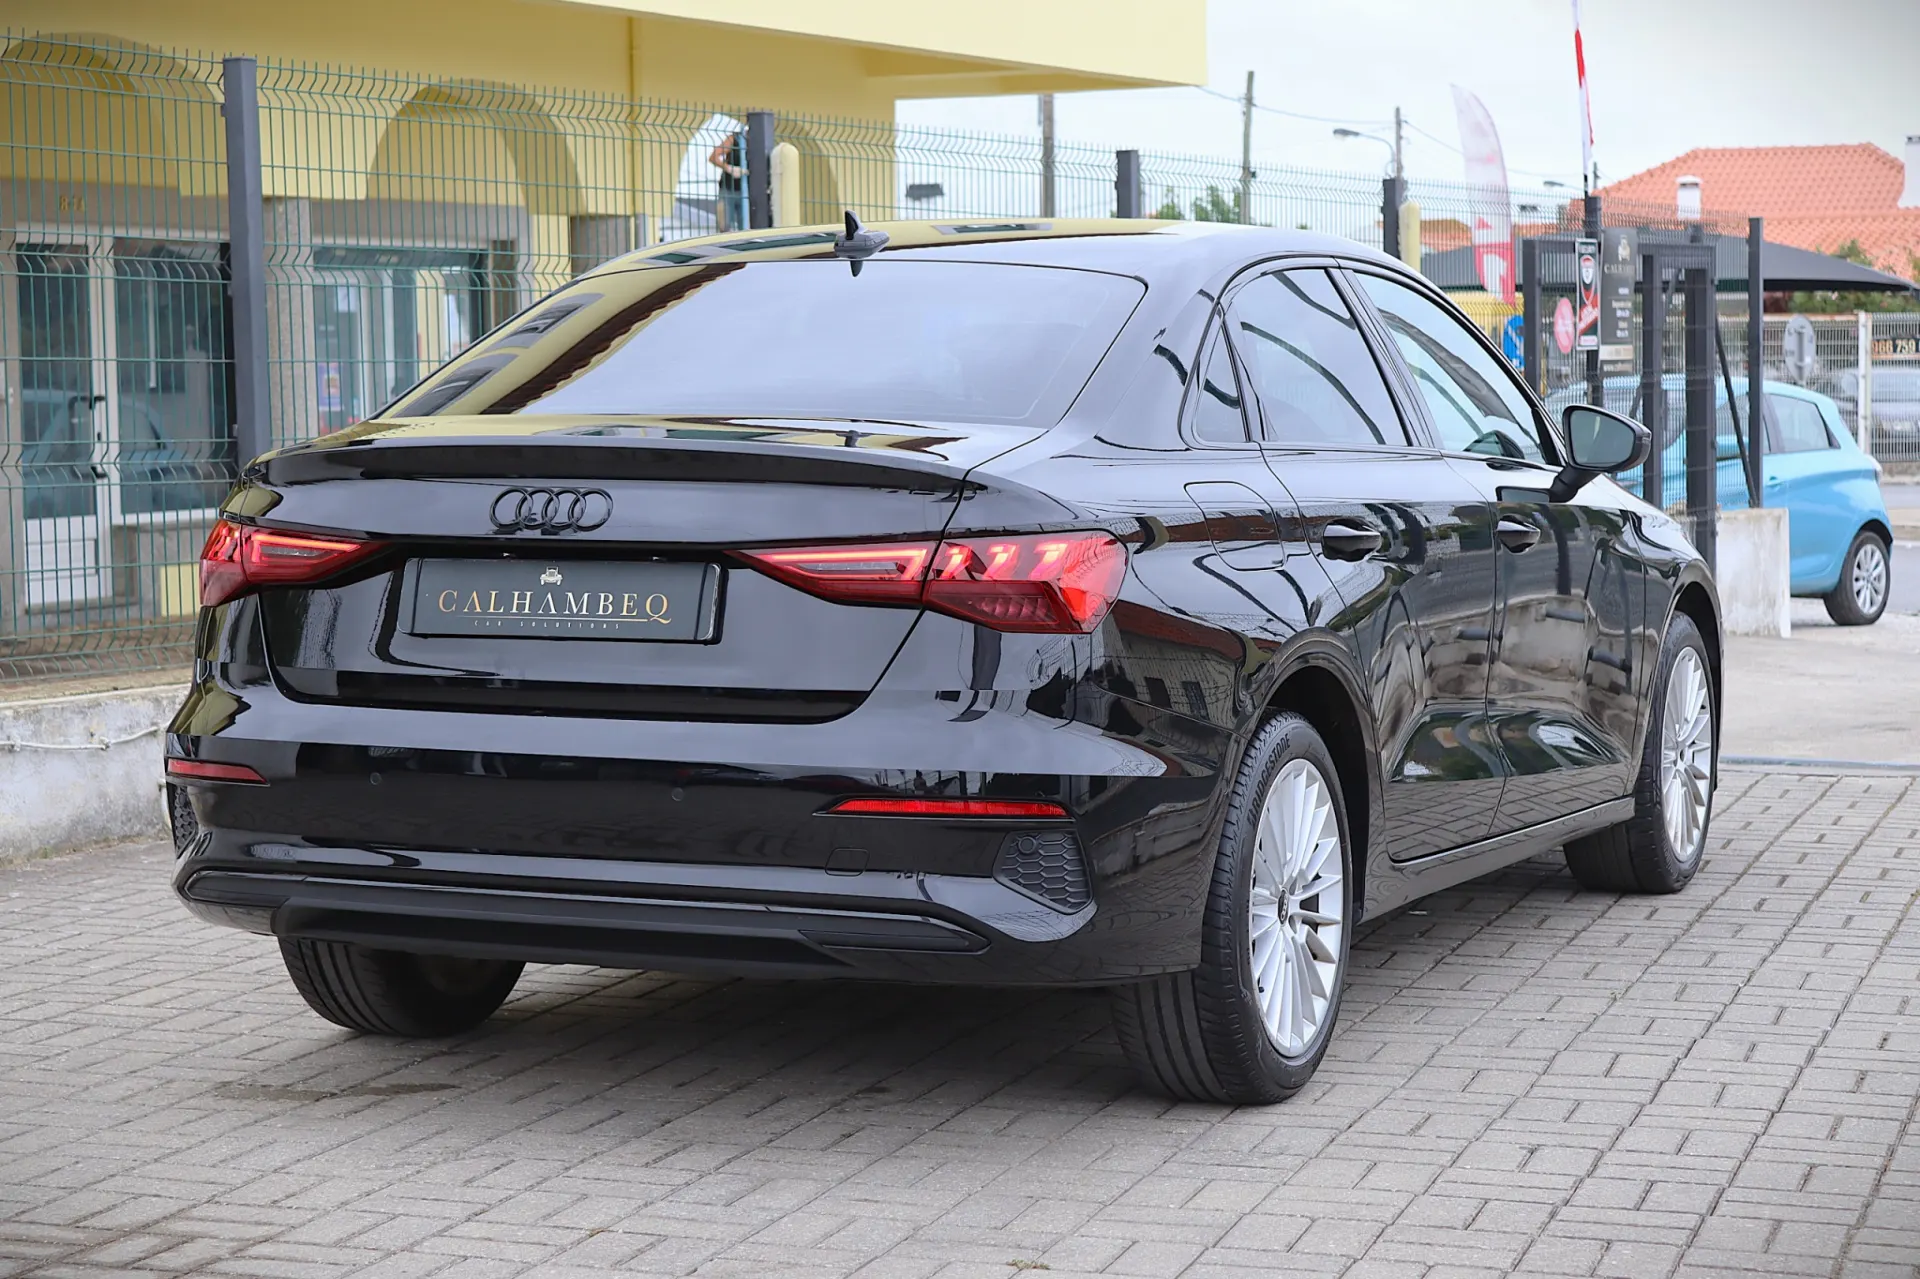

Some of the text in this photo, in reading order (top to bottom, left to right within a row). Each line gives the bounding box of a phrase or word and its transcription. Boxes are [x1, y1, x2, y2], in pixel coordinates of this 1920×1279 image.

[438, 589, 672, 624] CALHAMBEQ
[520, 621, 620, 630] SOLUTIONS
[1247, 733, 1291, 830] BRIDGESTONE
